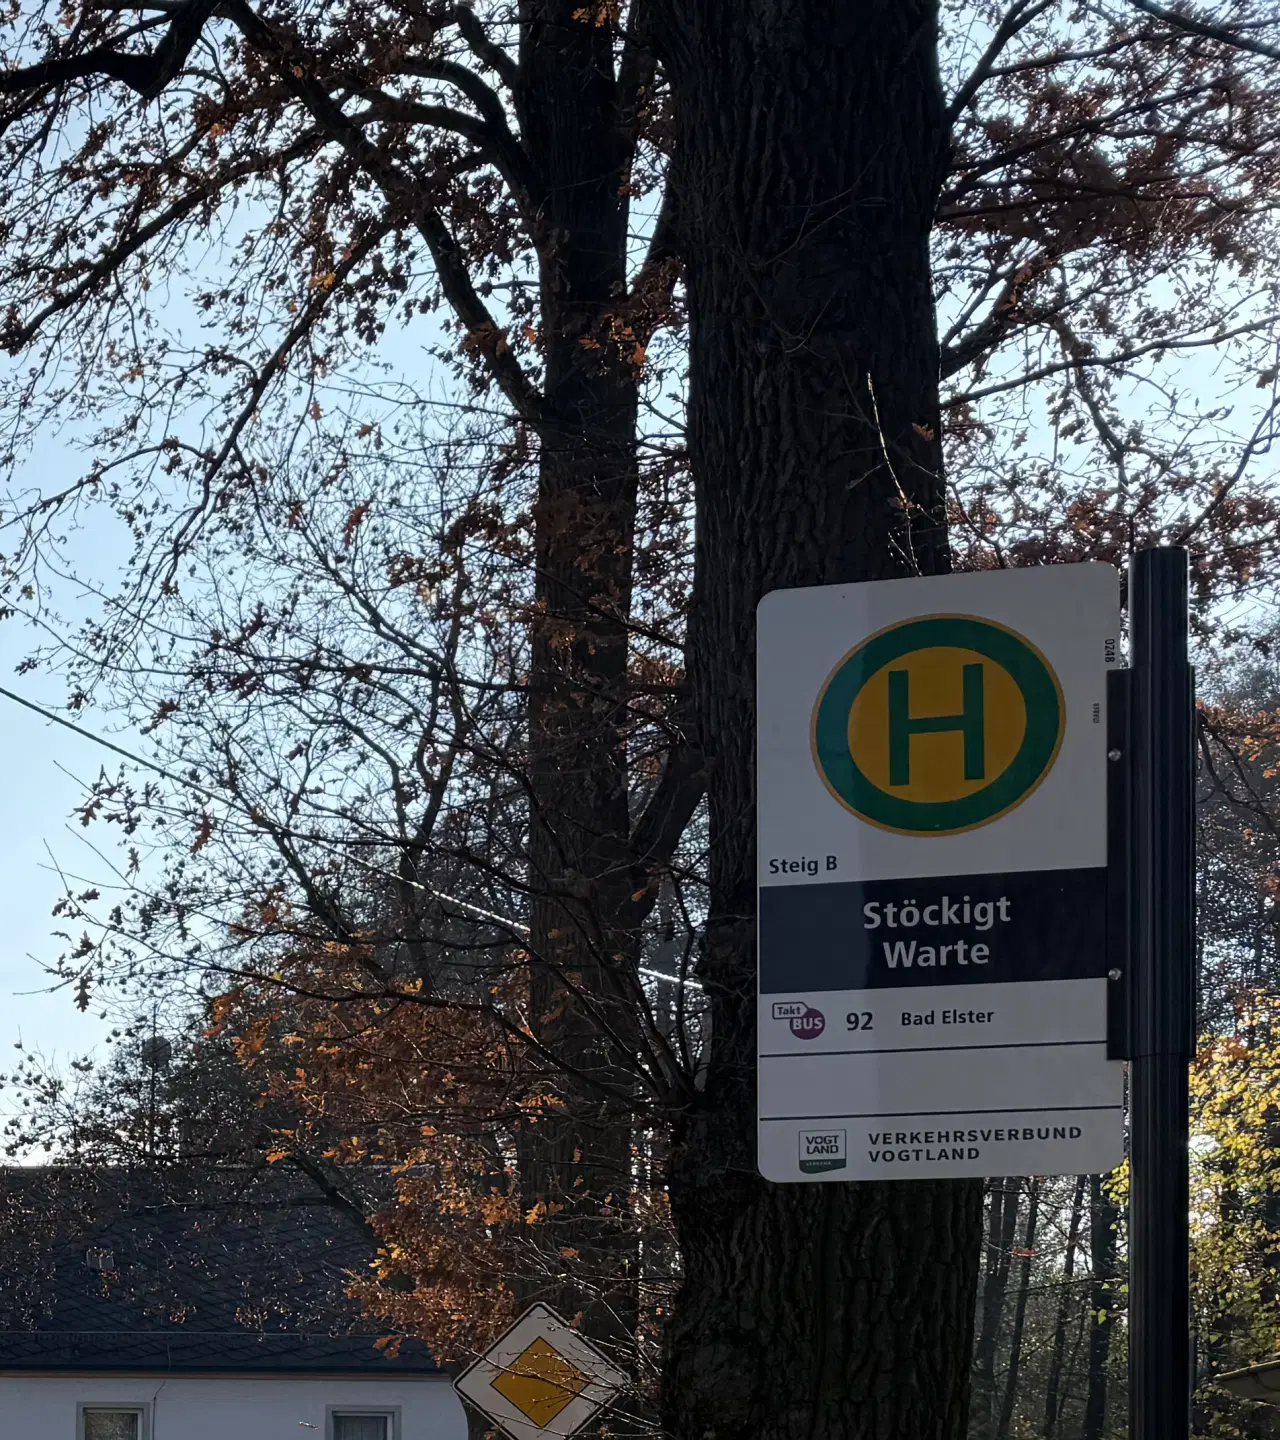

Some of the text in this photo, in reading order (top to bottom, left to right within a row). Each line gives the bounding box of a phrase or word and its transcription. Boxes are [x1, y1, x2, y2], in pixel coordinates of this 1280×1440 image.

[888, 663, 985, 786] H
[769, 856, 838, 875] Steig B
[863, 896, 1012, 930] Stöckigt
[882, 939, 990, 968] Warte
[777, 1006, 802, 1016] Takt
[846, 1009, 995, 1031] 92 Bad Elster
[792, 1016, 823, 1030] BUS
[806, 1135, 839, 1145] VOGT
[868, 1126, 1082, 1145] VERKEHRSVERBUND
[806, 1145, 839, 1155] LAND
[868, 1148, 980, 1163] VOGTLAND
